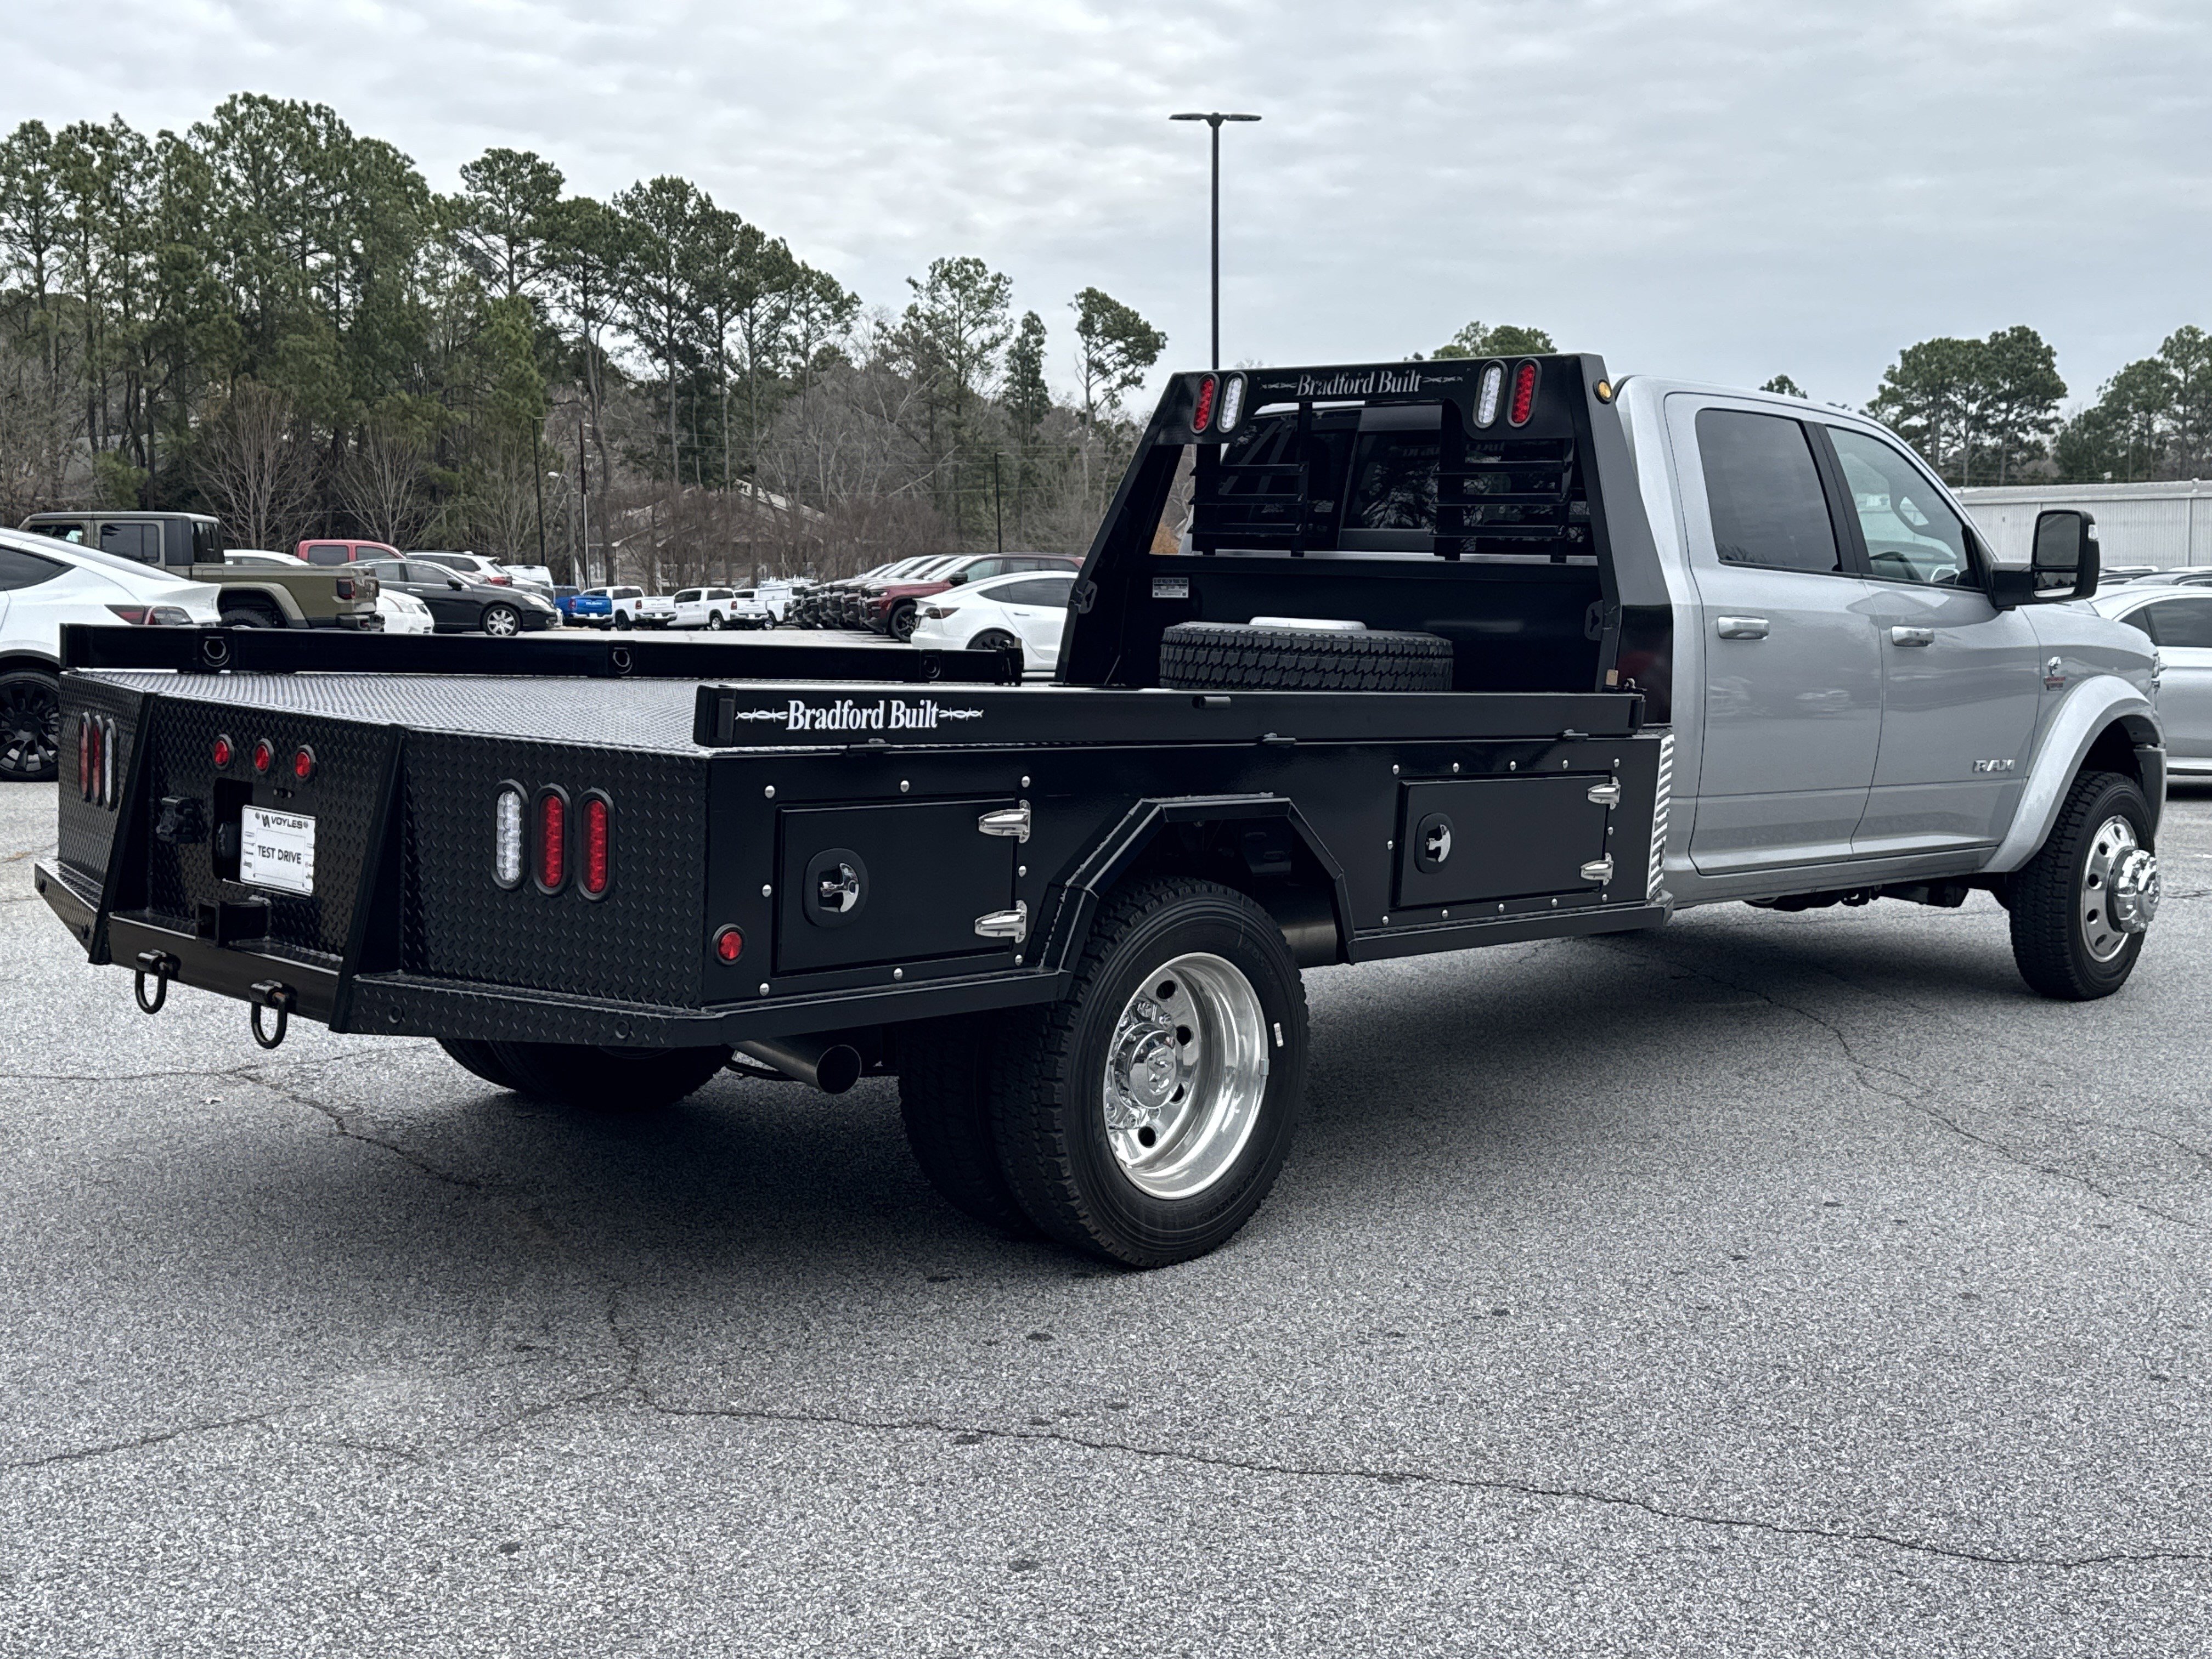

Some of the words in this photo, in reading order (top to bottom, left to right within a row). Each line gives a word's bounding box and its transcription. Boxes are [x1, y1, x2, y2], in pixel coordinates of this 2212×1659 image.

[1295, 371, 1375, 396] Bradford
[1377, 369, 1422, 393] Built
[786, 699, 884, 730] Bradford
[888, 699, 938, 729] Built
[1973, 759, 2016, 772] RAM
[271, 816, 303, 829] VOYLES
[257, 845, 276, 859] TEST
[278, 849, 302, 865] DRIVE
